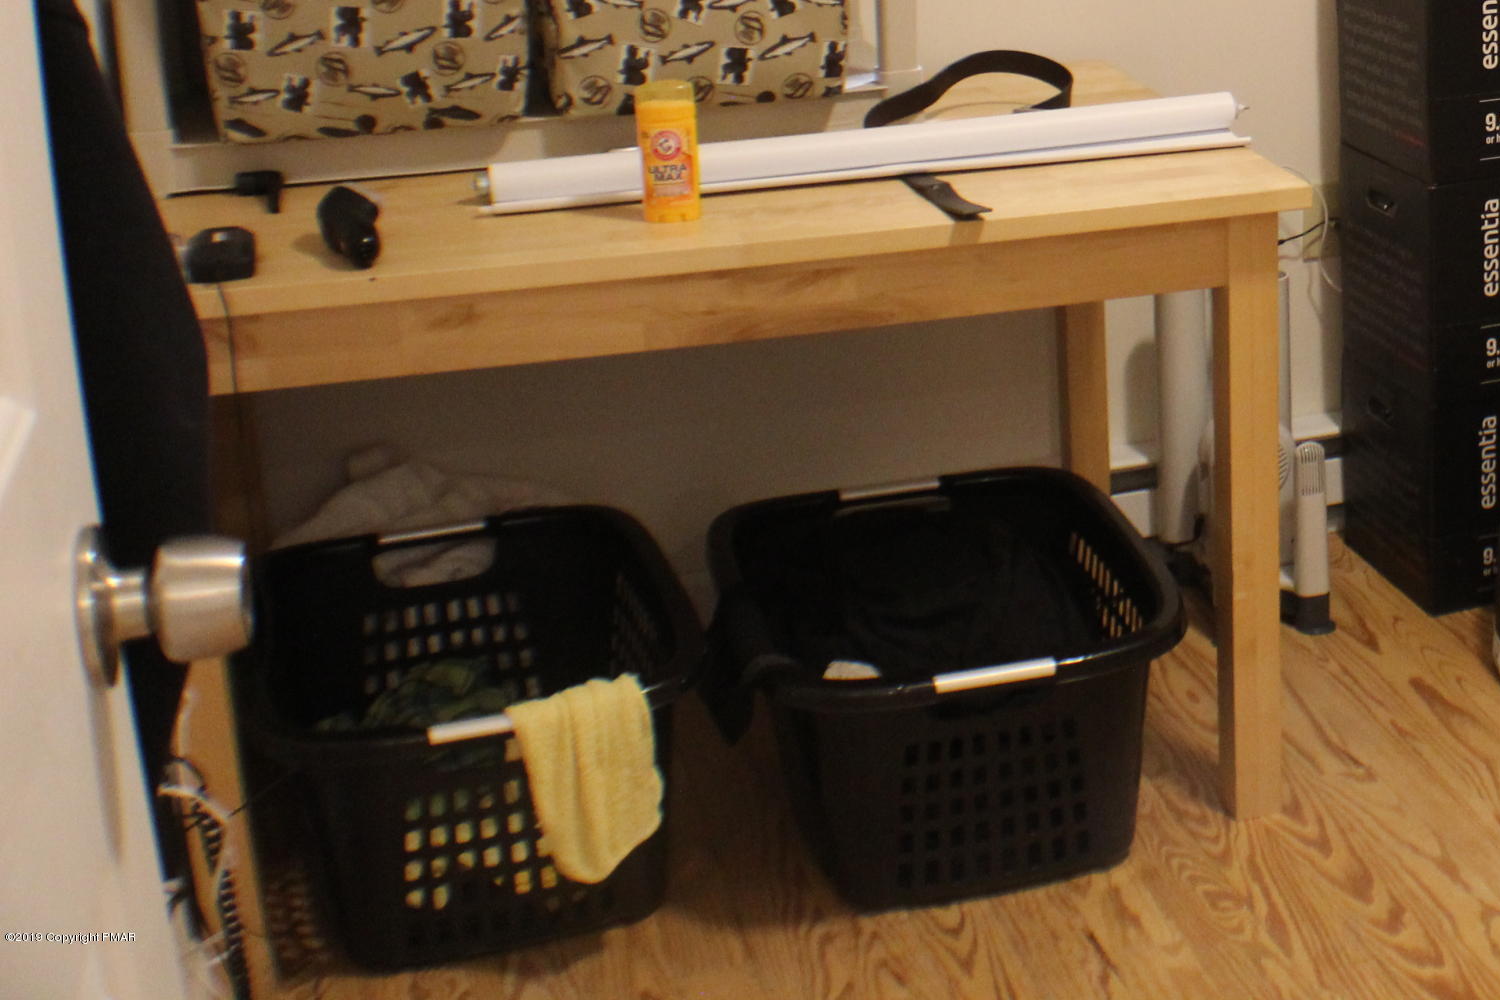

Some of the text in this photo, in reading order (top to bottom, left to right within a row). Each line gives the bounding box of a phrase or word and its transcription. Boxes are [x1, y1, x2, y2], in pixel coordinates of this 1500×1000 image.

[1485, 136, 1495, 145] or
[648, 164, 687, 175] ULTRA
[653, 172, 682, 182] MAX
[1480, 198, 1500, 297] essentia
[1486, 360, 1495, 368] or
[1478, 415, 1498, 509] essentia
